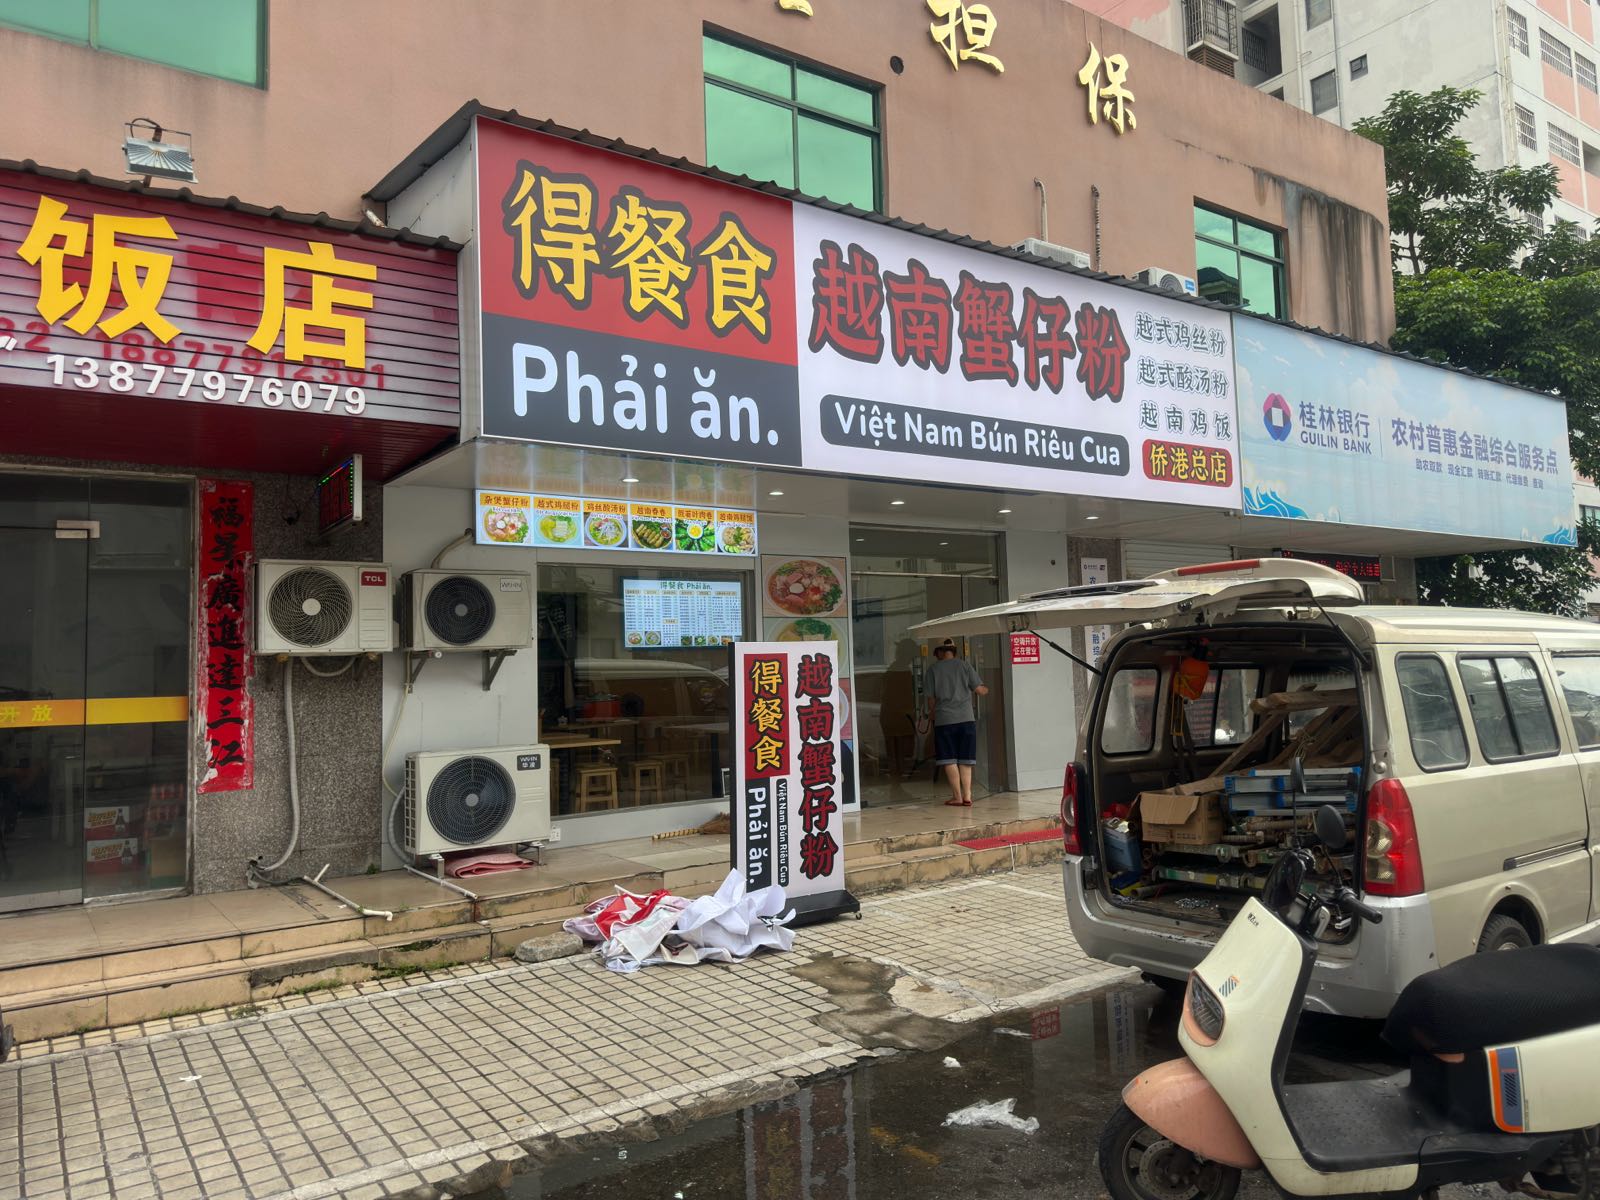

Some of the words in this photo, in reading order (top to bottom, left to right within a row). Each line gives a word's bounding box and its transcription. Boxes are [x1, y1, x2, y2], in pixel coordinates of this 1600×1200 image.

[506, 164, 775, 339] 得餐食
[17, 195, 377, 369] 饭店
[809, 240, 1130, 401] 越南蟹仔粉
[1136, 313, 1226, 356] 越式鸡丝粉
[46, 354, 367, 415] 13877976079
[511, 342, 668, 434] Phải
[690, 366, 779, 446] ăn.
[1138, 358, 1228, 397] 越式酸汤粉
[834, 401, 898, 447] Việt
[904, 411, 963, 448] Nam
[971, 413, 1018, 454] Bún
[1024, 428, 1074, 461] Riêu
[1081, 441, 1121, 466] Cua
[1140, 402, 1232, 439] 越南鸡饭
[1298, 401, 1371, 439] 桂林银行
[1149, 444, 1227, 483] 侨港总店
[1300, 431, 1339, 450] GUILIN
[1343, 439, 1372, 455] BANK
[1391, 417, 1559, 475] 农村普惠金融综合服务点
[751, 660, 784, 772] 得餐食
[796, 653, 839, 880] 越南蟹仔粉
[776, 782, 787, 801] Việt
[778, 803, 787, 822] Nam
[748, 786, 768, 841] Phải
[779, 824, 787, 843] Bún
[749, 847, 768, 884] ăn.
[779, 843, 788, 864] Riêu
